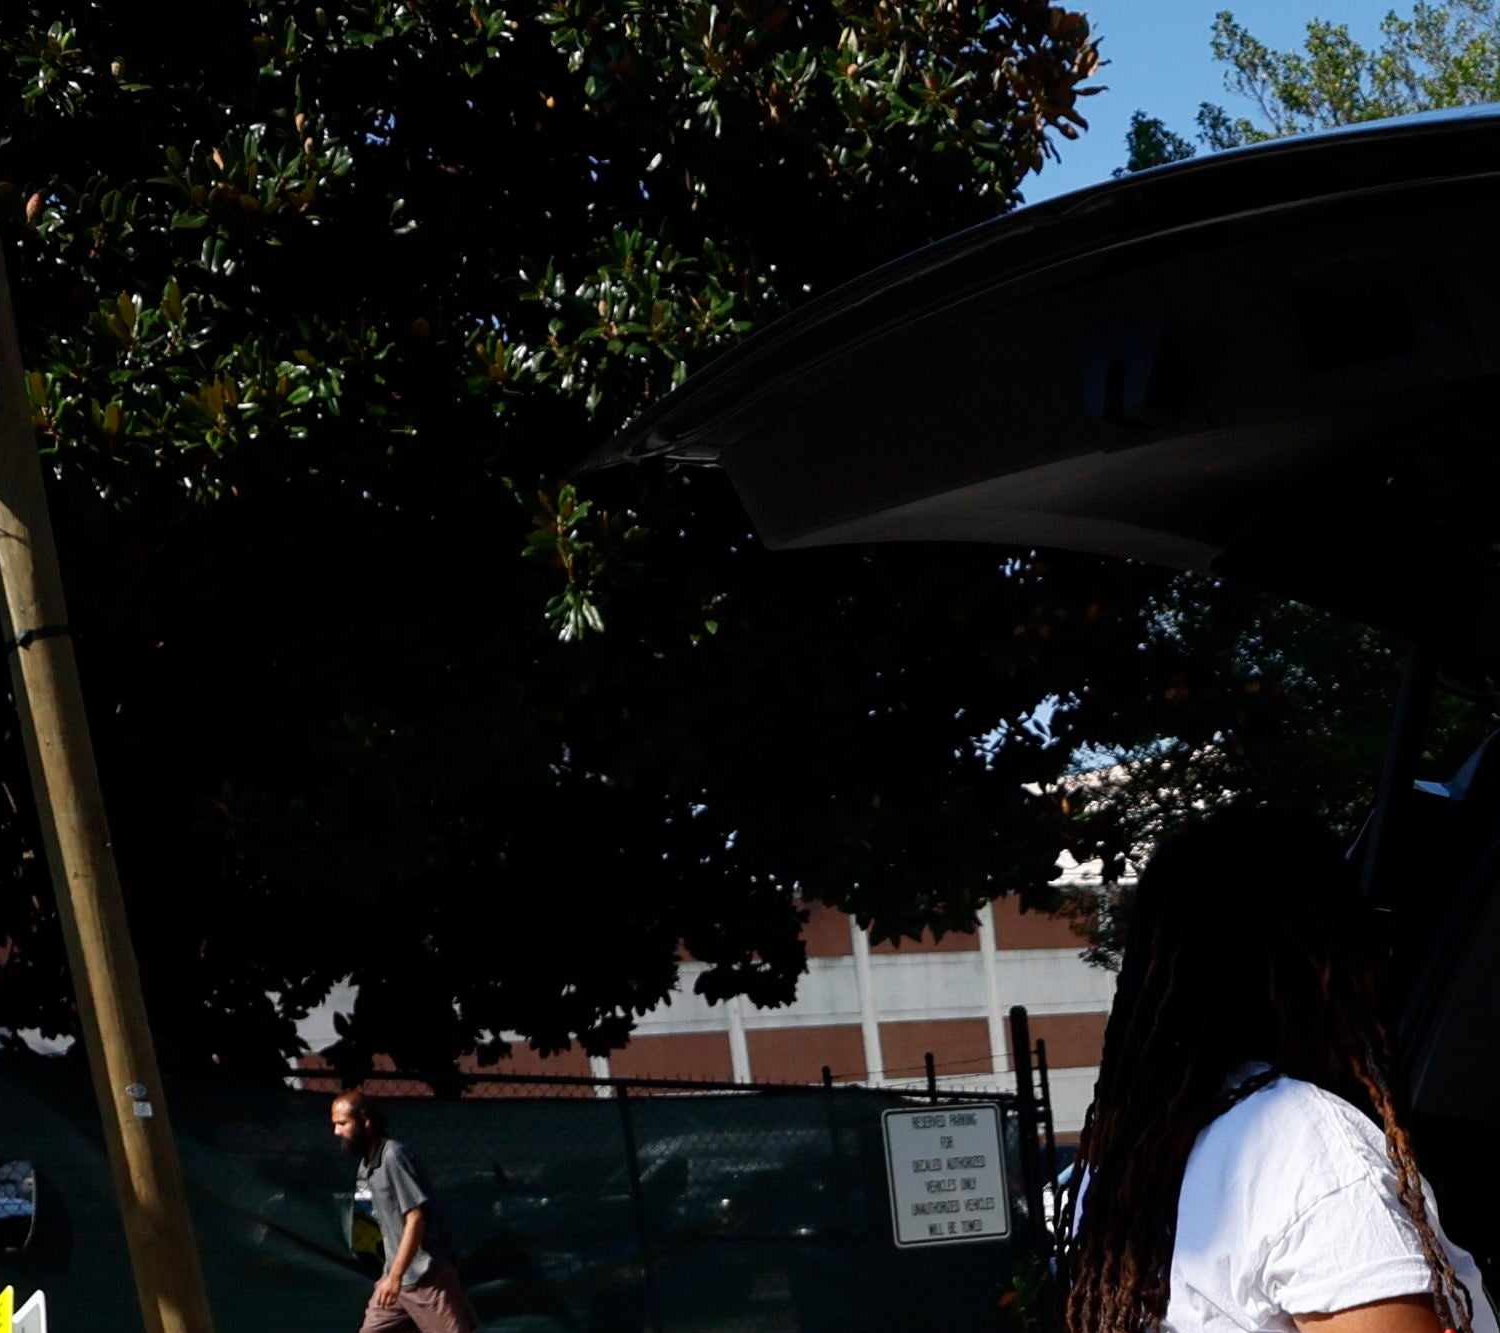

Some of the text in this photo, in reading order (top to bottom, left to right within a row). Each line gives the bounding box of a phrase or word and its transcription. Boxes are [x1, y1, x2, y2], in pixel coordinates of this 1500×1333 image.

[911, 1113, 978, 1129] RESERVED PARKING
[939, 1136, 954, 1149] FOR
[946, 1155, 986, 1170] AUTHORIZED
[925, 1177, 977, 1193] VEHICLES ONLY
[911, 1197, 995, 1216] UNAUTHORIZED VEHICLES
[928, 1219, 983, 1236] WILL BE TOWED
